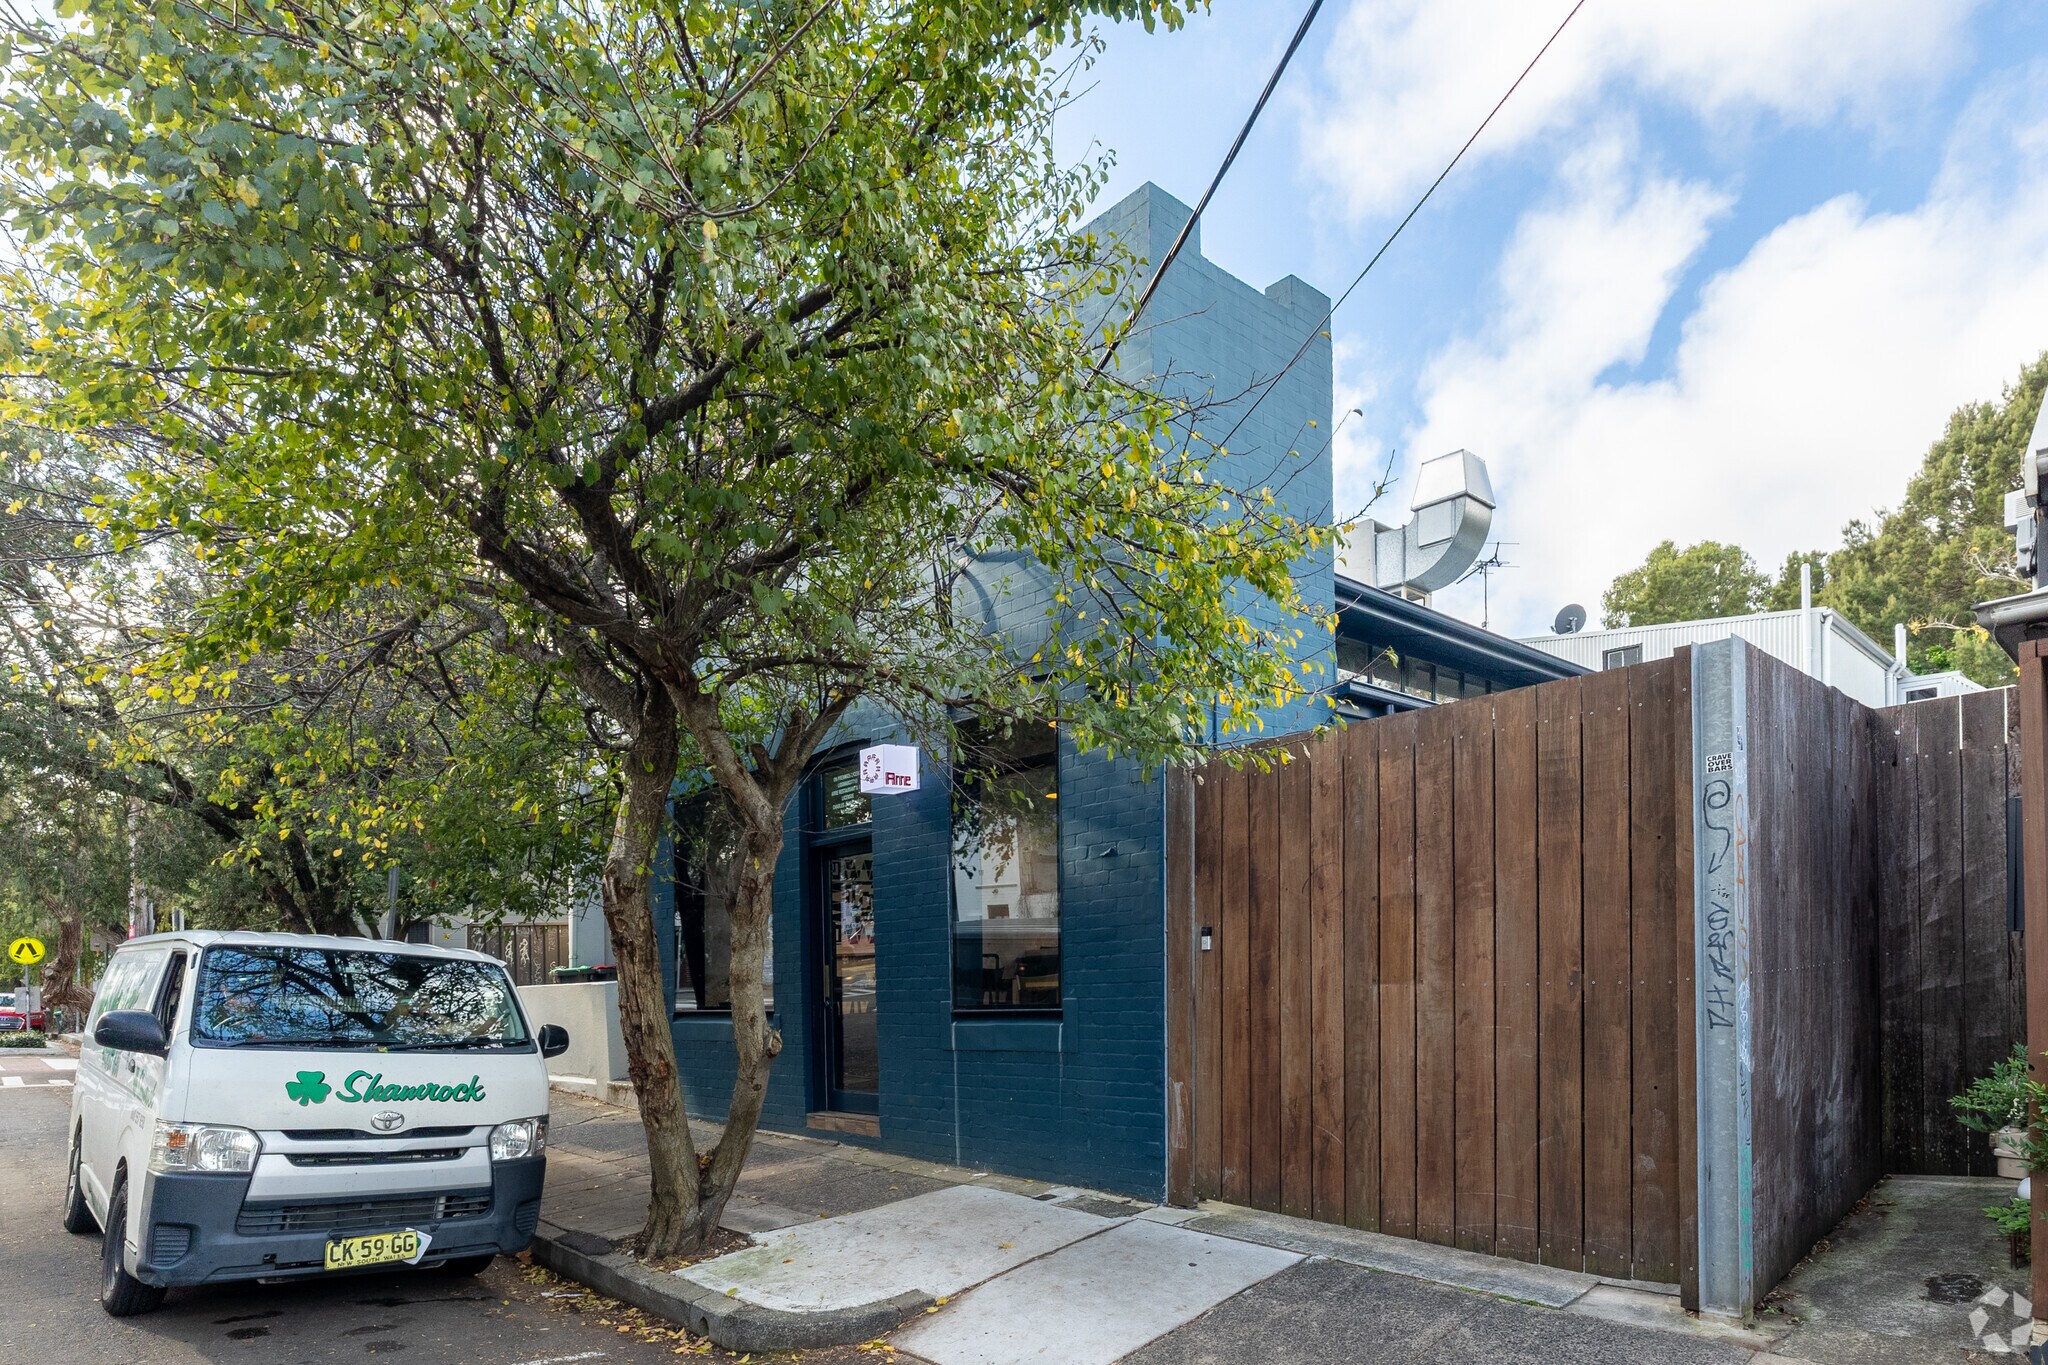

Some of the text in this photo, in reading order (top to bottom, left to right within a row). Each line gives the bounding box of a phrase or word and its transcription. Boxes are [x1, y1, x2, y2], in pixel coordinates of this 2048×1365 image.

[1707, 752, 1732, 762] CRAVE
[1707, 759, 1732, 767] OVER
[1708, 764, 1733, 773] BARS
[885, 771, 912, 786] Arre
[335, 1070, 486, 1103] Shamrock
[337, 1260, 353, 1268] NEW
[356, 1257, 380, 1265] SOUTH
